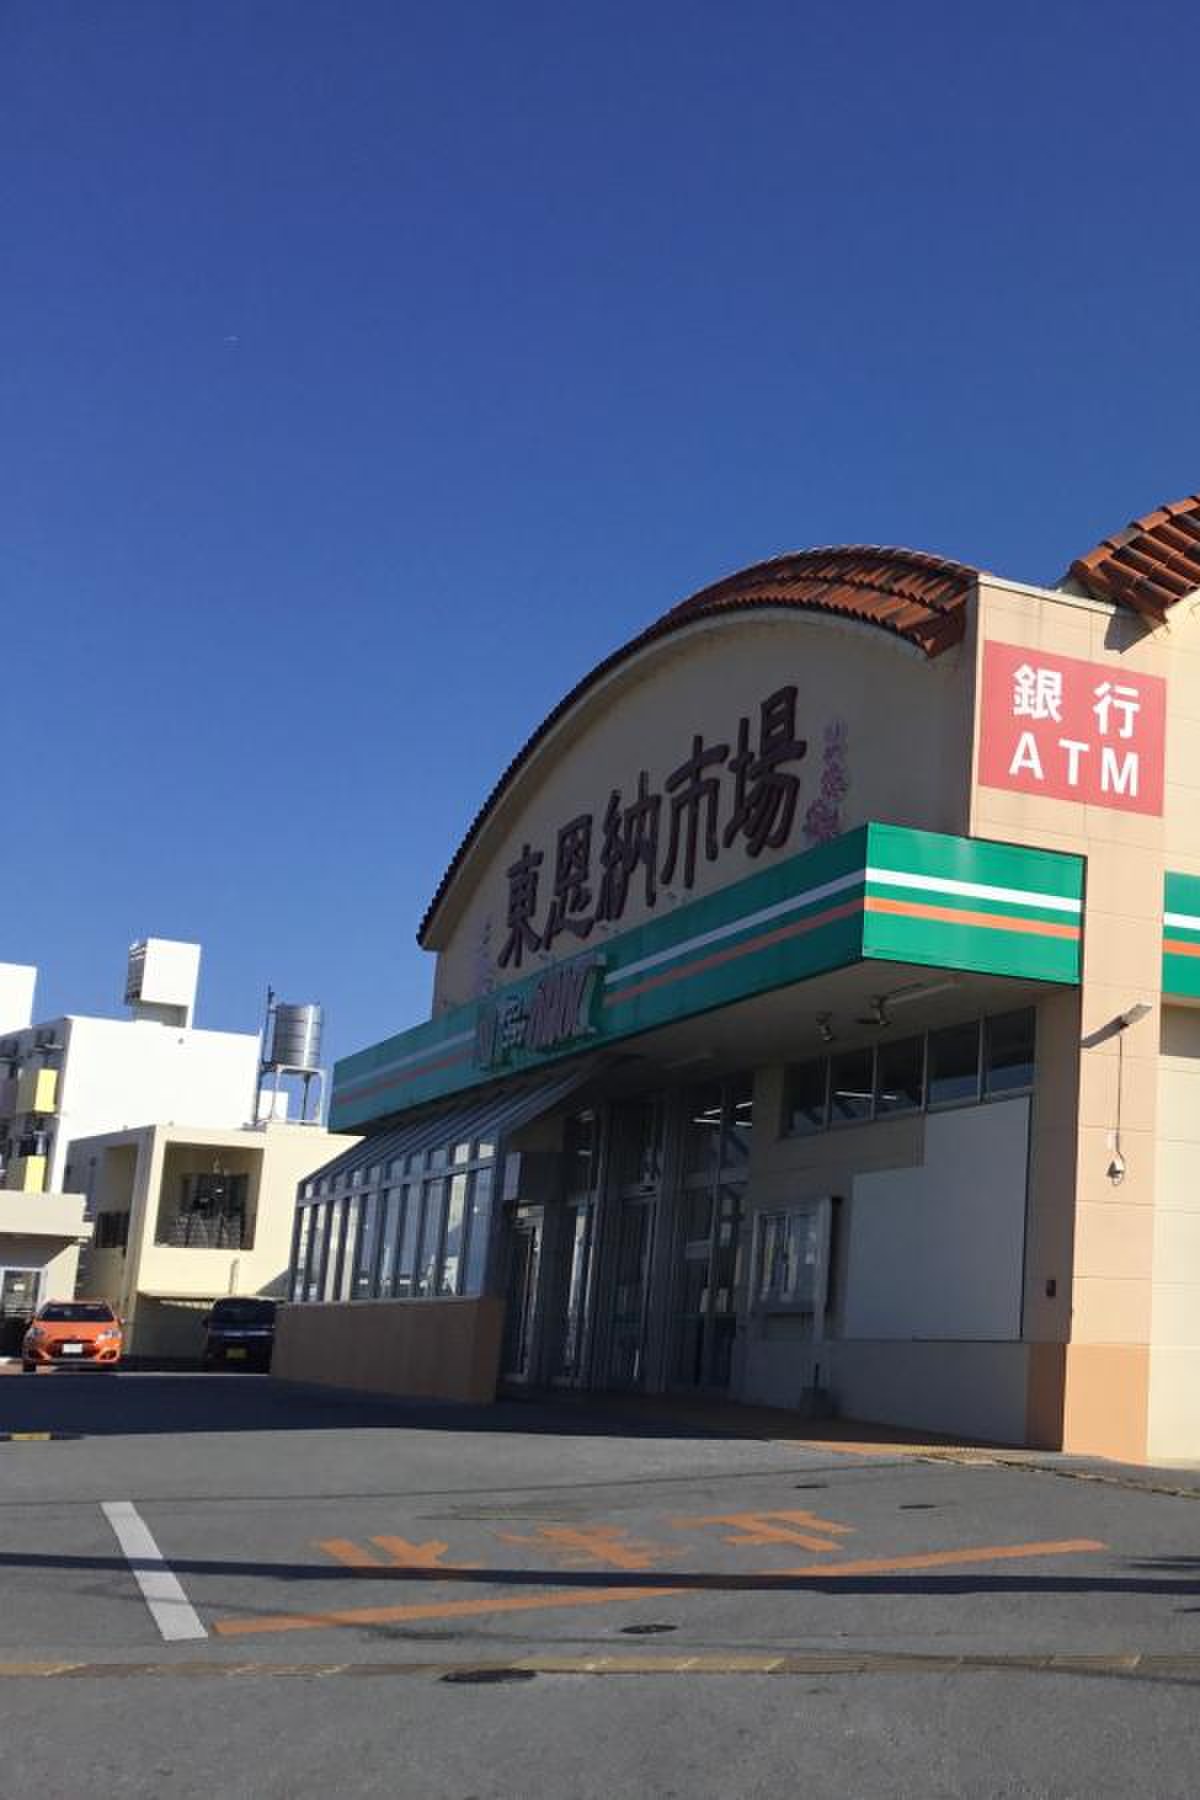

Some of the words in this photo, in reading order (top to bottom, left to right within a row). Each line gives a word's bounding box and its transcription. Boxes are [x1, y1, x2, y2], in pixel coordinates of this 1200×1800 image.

[1012, 663, 1141, 740] 銀行
[1008, 731, 1140, 798] ATM
[498, 684, 807, 969] 東恩納市場
